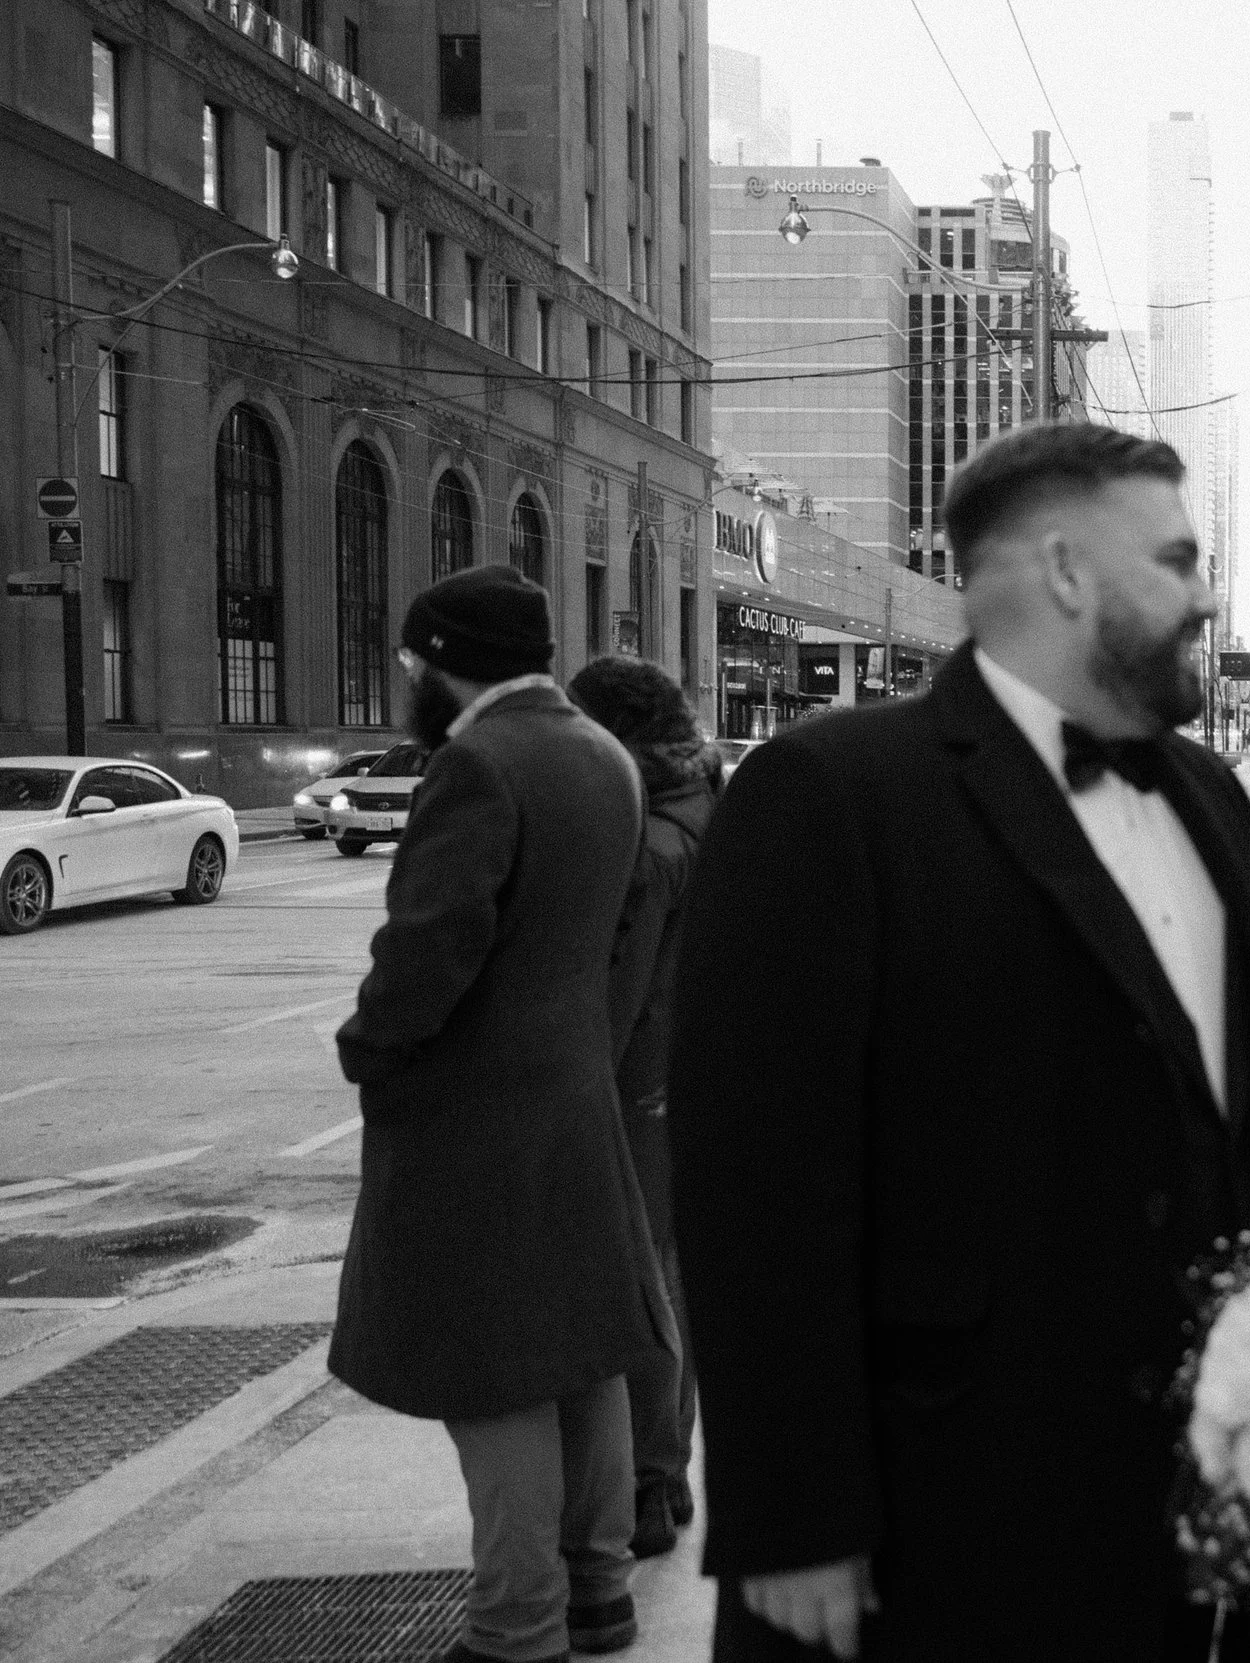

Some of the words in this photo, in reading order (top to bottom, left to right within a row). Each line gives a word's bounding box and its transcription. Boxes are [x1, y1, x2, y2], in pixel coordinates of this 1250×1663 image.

[774, 180, 877, 196] Northbridge
[714, 510, 754, 560] BMO
[740, 606, 768, 632] CACTUS
[771, 614, 788, 635] CLUB
[814, 666, 834, 675] VITA
